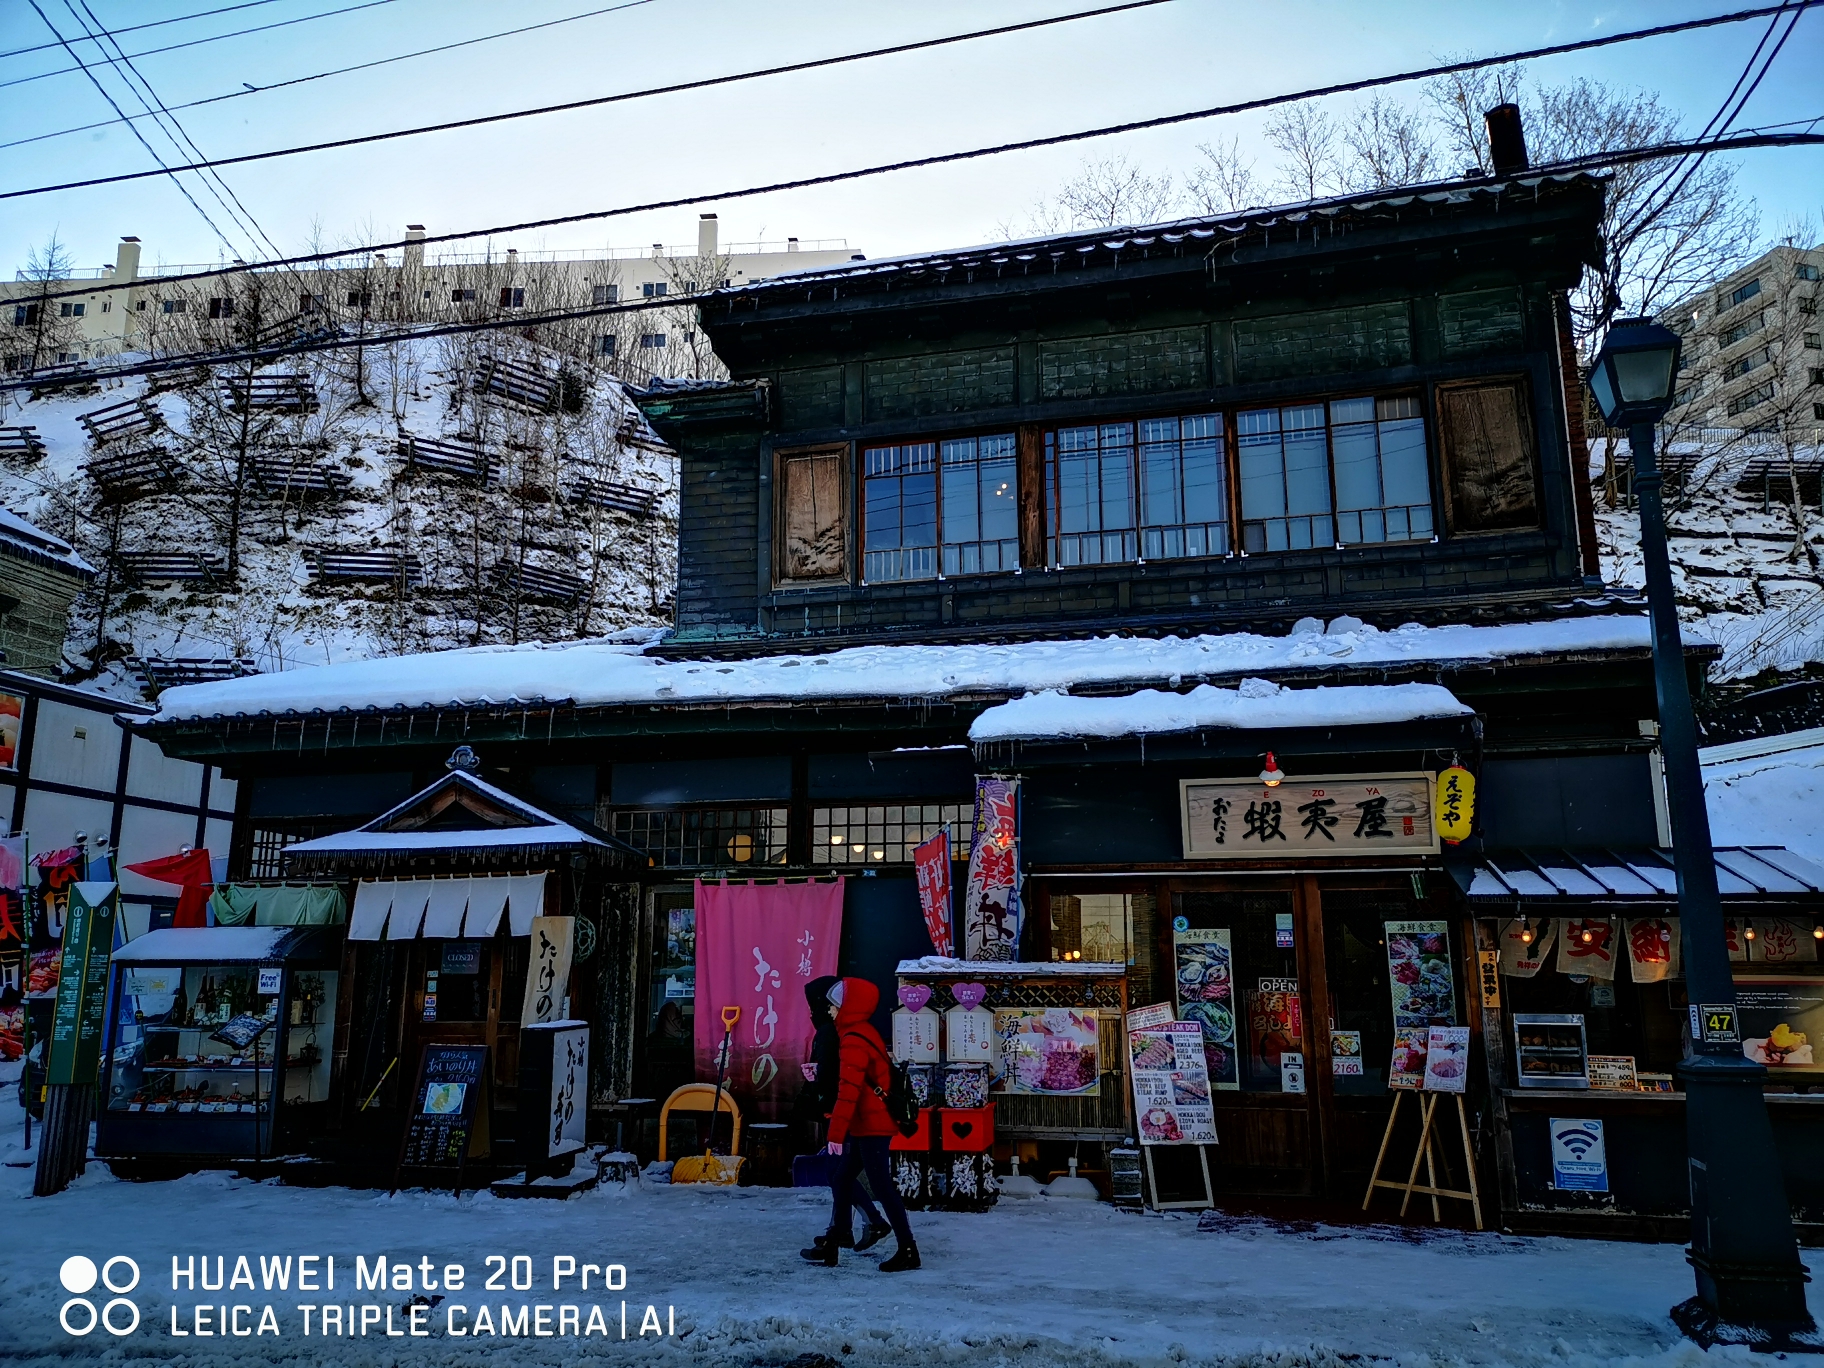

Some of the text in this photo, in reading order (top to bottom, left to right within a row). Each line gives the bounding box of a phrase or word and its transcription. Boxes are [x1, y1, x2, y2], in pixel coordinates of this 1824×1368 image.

[1263, 787, 1380, 799] E ZO YA
[1442, 775, 1462, 828] えぞや
[1242, 796, 1394, 842] 蝦夷屋
[1397, 922, 1437, 932] 海鮮食堂
[447, 953, 474, 962] CLOSED
[796, 929, 815, 978] 小樽
[260, 973, 277, 981] Free
[536, 930, 557, 1023] たけの
[1261, 982, 1298, 992] OPEN
[749, 946, 782, 1092] たけの
[1709, 1015, 1731, 1030] 47
[1186, 1022, 1199, 1032] DON
[999, 1014, 1022, 1086] 海鮮丼
[1334, 1064, 1358, 1074] 2160
